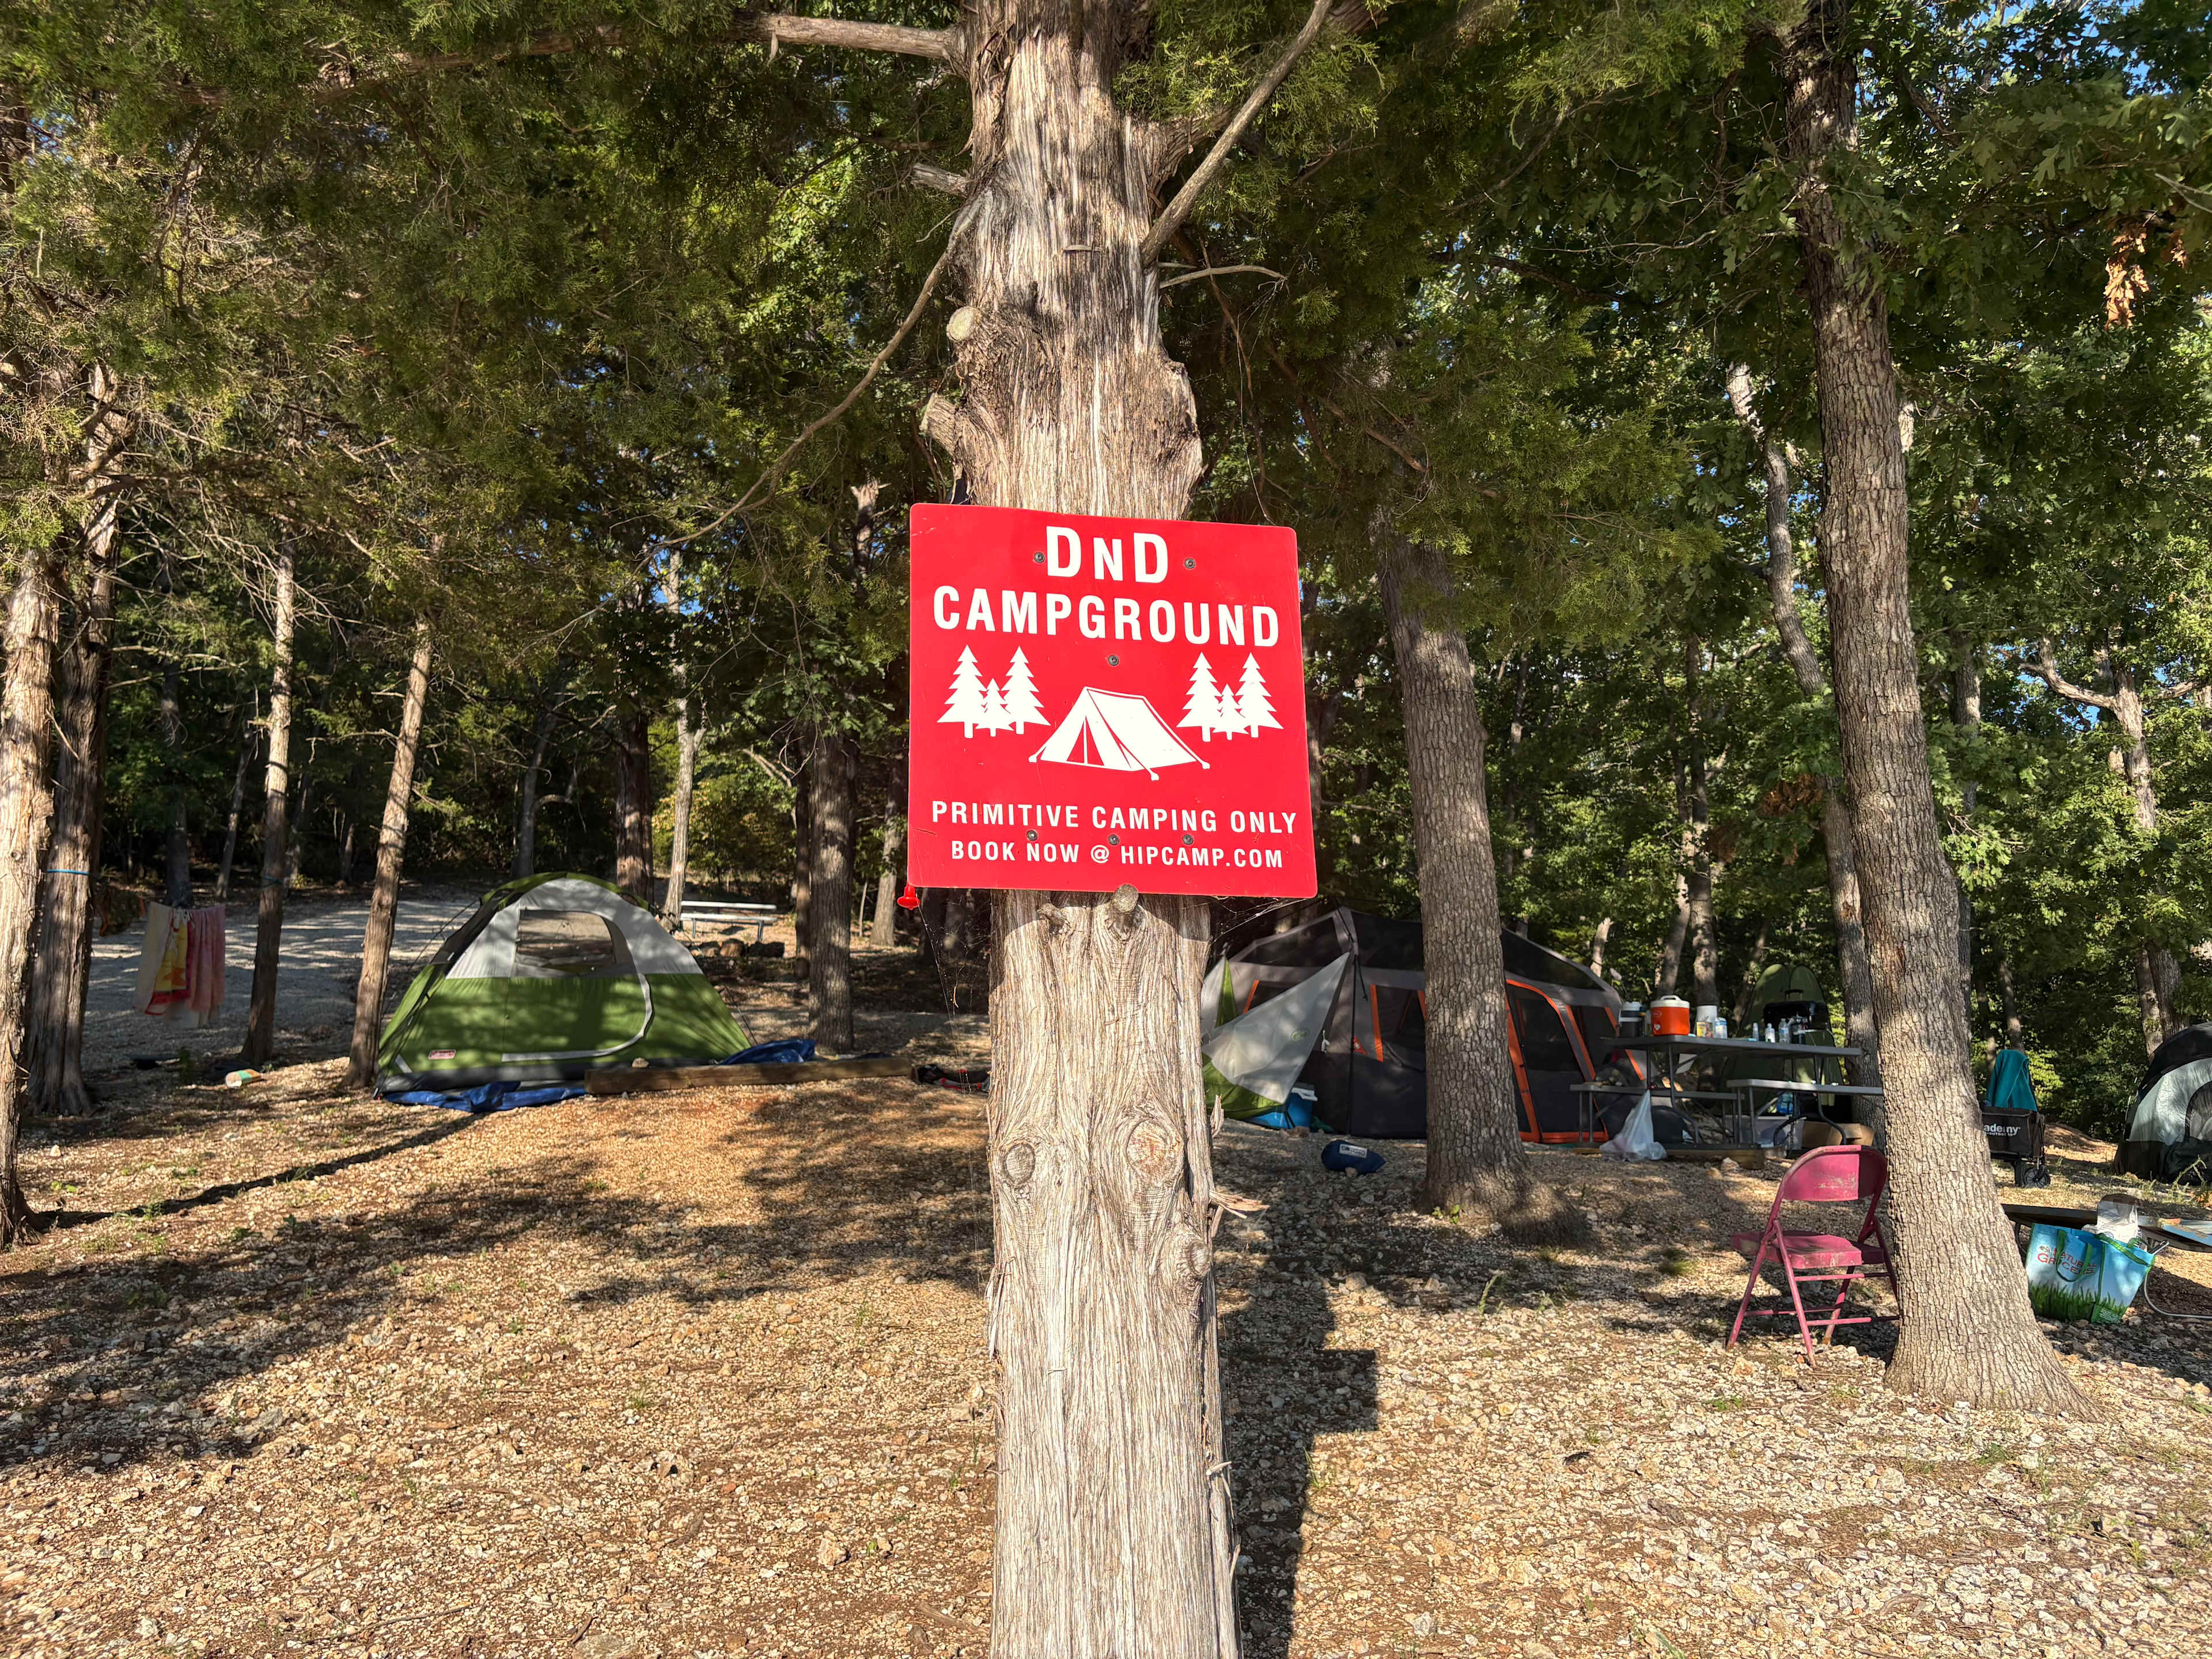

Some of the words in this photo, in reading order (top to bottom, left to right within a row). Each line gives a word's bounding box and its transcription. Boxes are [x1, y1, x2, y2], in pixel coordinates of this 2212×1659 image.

[933, 585, 1279, 647] CAMPGROUND
[932, 800, 1079, 828] PRIMITIVE
[1092, 806, 1217, 832] CAMPING
[1230, 810, 1297, 834] ONLY
[952, 840, 1016, 861] BOOK
[1027, 843, 1080, 863] NOW
[1090, 844, 1109, 864] @
[1121, 846, 1282, 868] HIPCAMP.COM
[1983, 1123, 2019, 1136] ademy
[2037, 1253, 2094, 1275] GRCES
